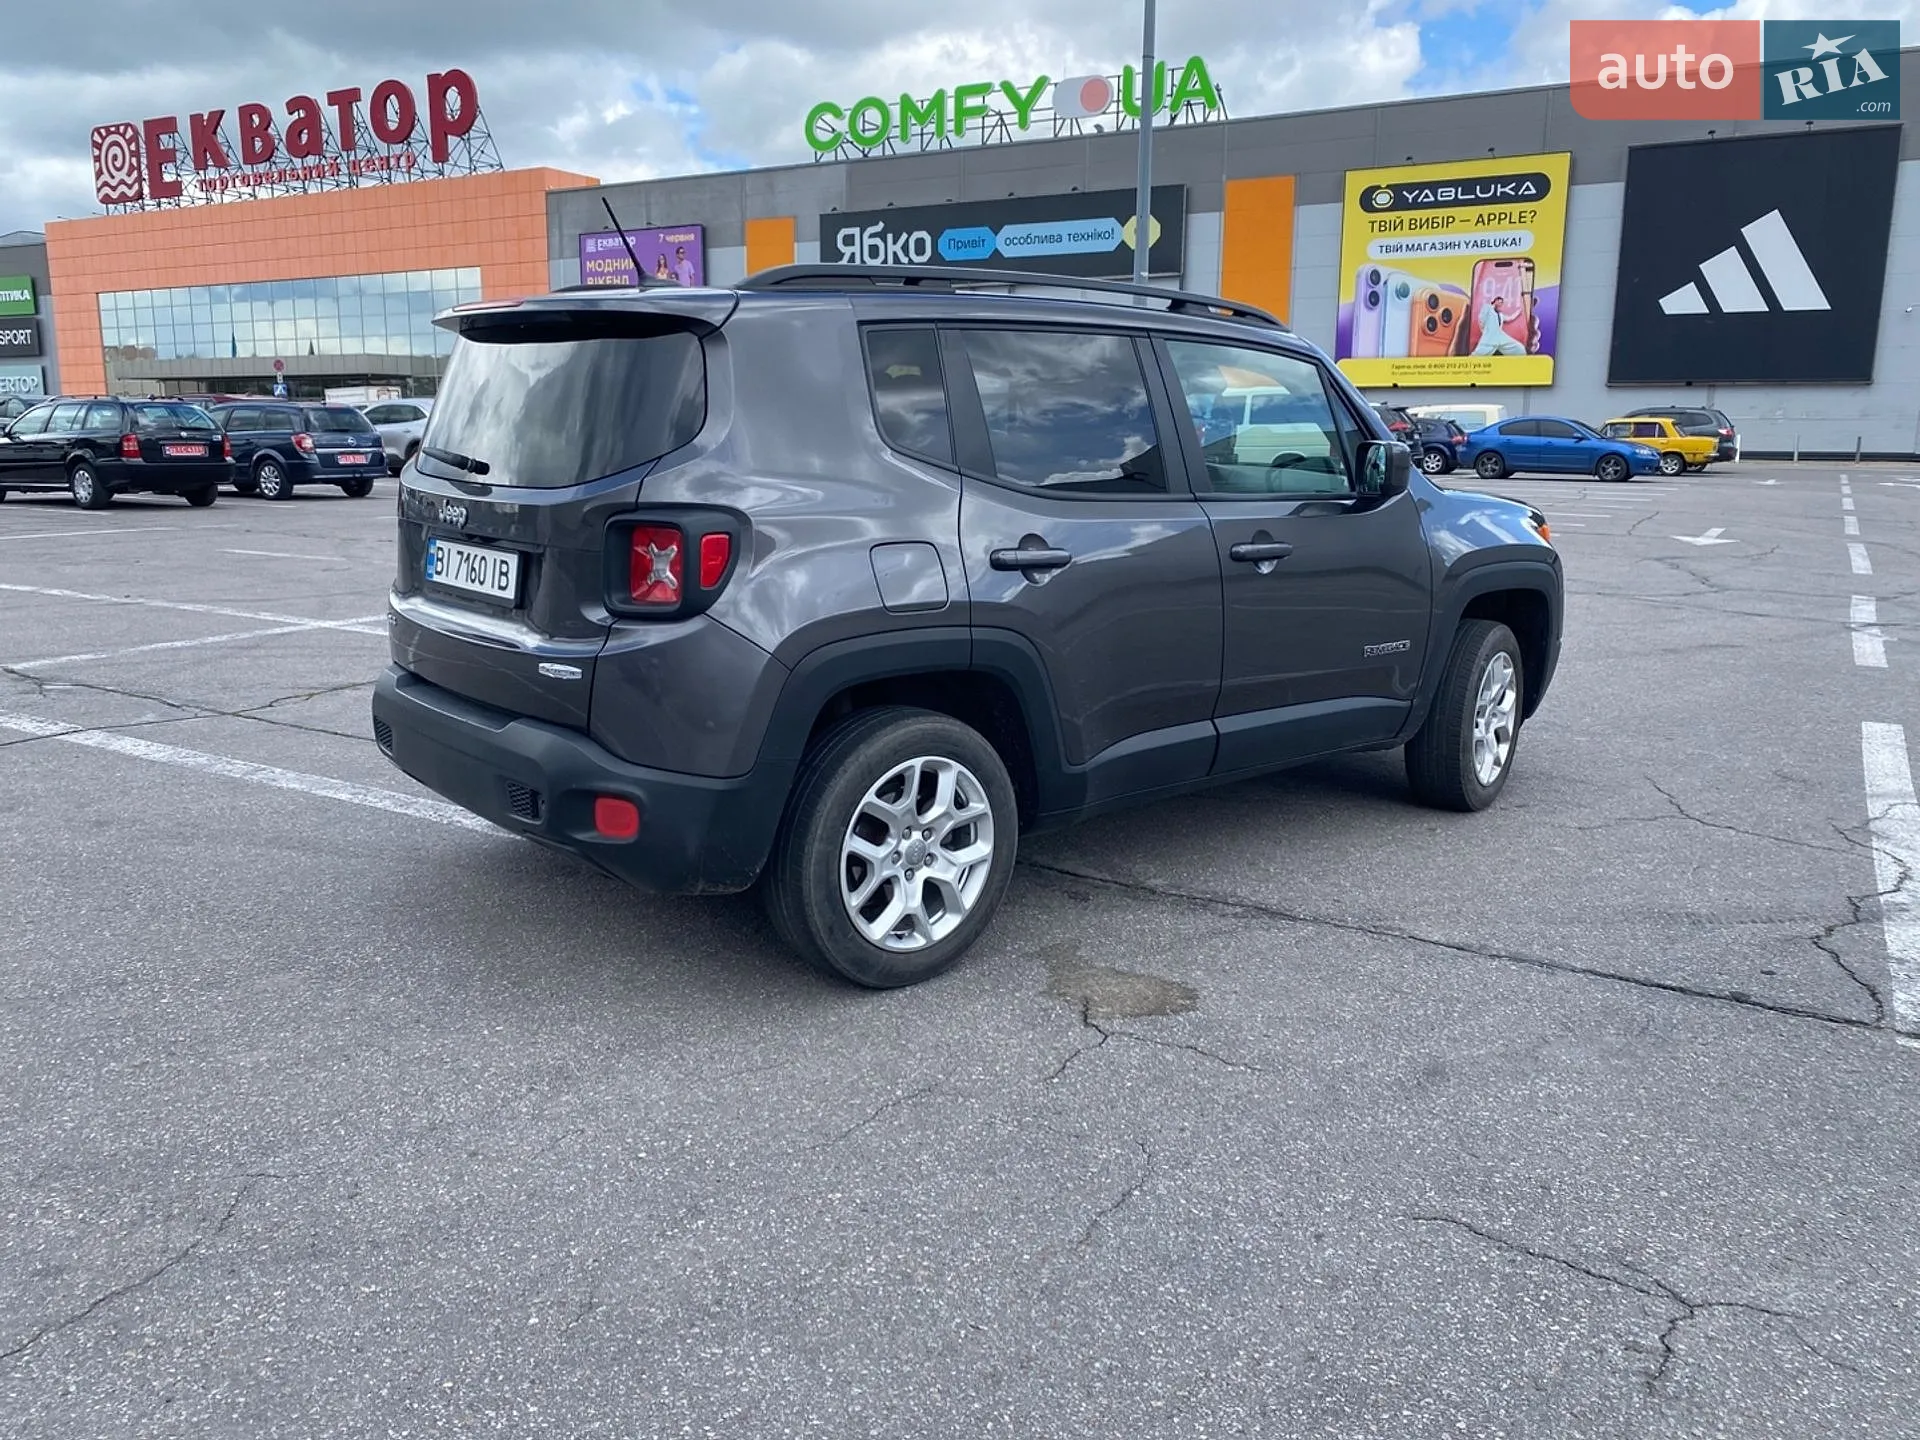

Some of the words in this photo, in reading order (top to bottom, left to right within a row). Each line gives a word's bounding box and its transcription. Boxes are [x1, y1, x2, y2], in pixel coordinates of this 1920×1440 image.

[805, 75, 1052, 153] COMFY
[1122, 55, 1220, 118] UA
[143, 69, 479, 199] Екватор
[349, 152, 415, 177] центр
[1402, 181, 1537, 203] YABLUKA
[1369, 216, 1404, 233] ТВІЙ
[1408, 215, 1456, 231] ВИБІР
[1475, 210, 1537, 226] APPLE?
[836, 220, 932, 265] Ябко
[947, 236, 987, 251] Привіт
[1004, 233, 1063, 248] особлива
[1067, 227, 1115, 243] техніко!
[1378, 241, 1404, 254] ТВІЙ
[1405, 240, 1461, 253] МАГАЗИН
[1464, 237, 1522, 250] YABLUKA!
[0, 329, 32, 346] SPORT
[438, 499, 468, 529] Jeep
[435, 546, 451, 578] BI
[455, 550, 487, 586] 7160
[491, 557, 510, 591] IB
